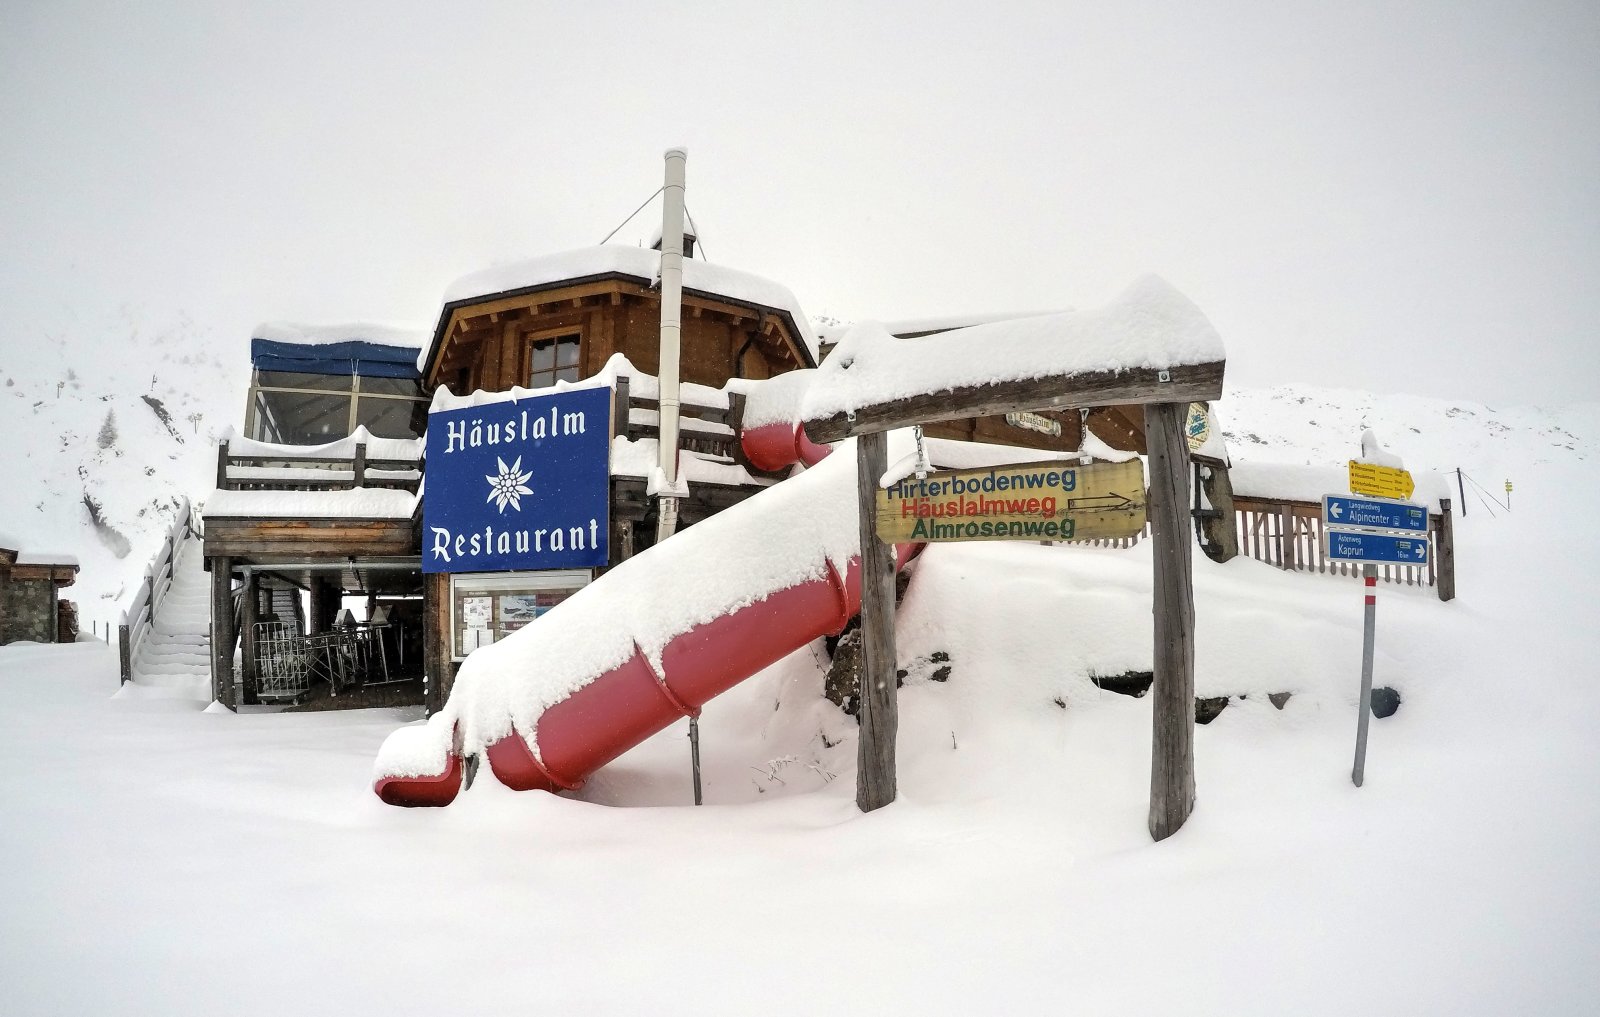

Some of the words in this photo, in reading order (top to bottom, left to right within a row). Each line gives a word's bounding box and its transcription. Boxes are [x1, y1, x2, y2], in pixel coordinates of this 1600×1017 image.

[444, 406, 586, 454] Häuslalm
[887, 469, 1076, 500] Hirterbodenweg
[901, 494, 1056, 519] Häuslalmweg
[1348, 500, 1381, 513] Langwiedweg
[1349, 510, 1390, 524] Alpincenter
[911, 517, 1076, 539] Almrosenweg
[430, 518, 599, 563] Restaurant
[1338, 534, 1362, 545] Astenweg
[1338, 543, 1364, 557] Kaprun
